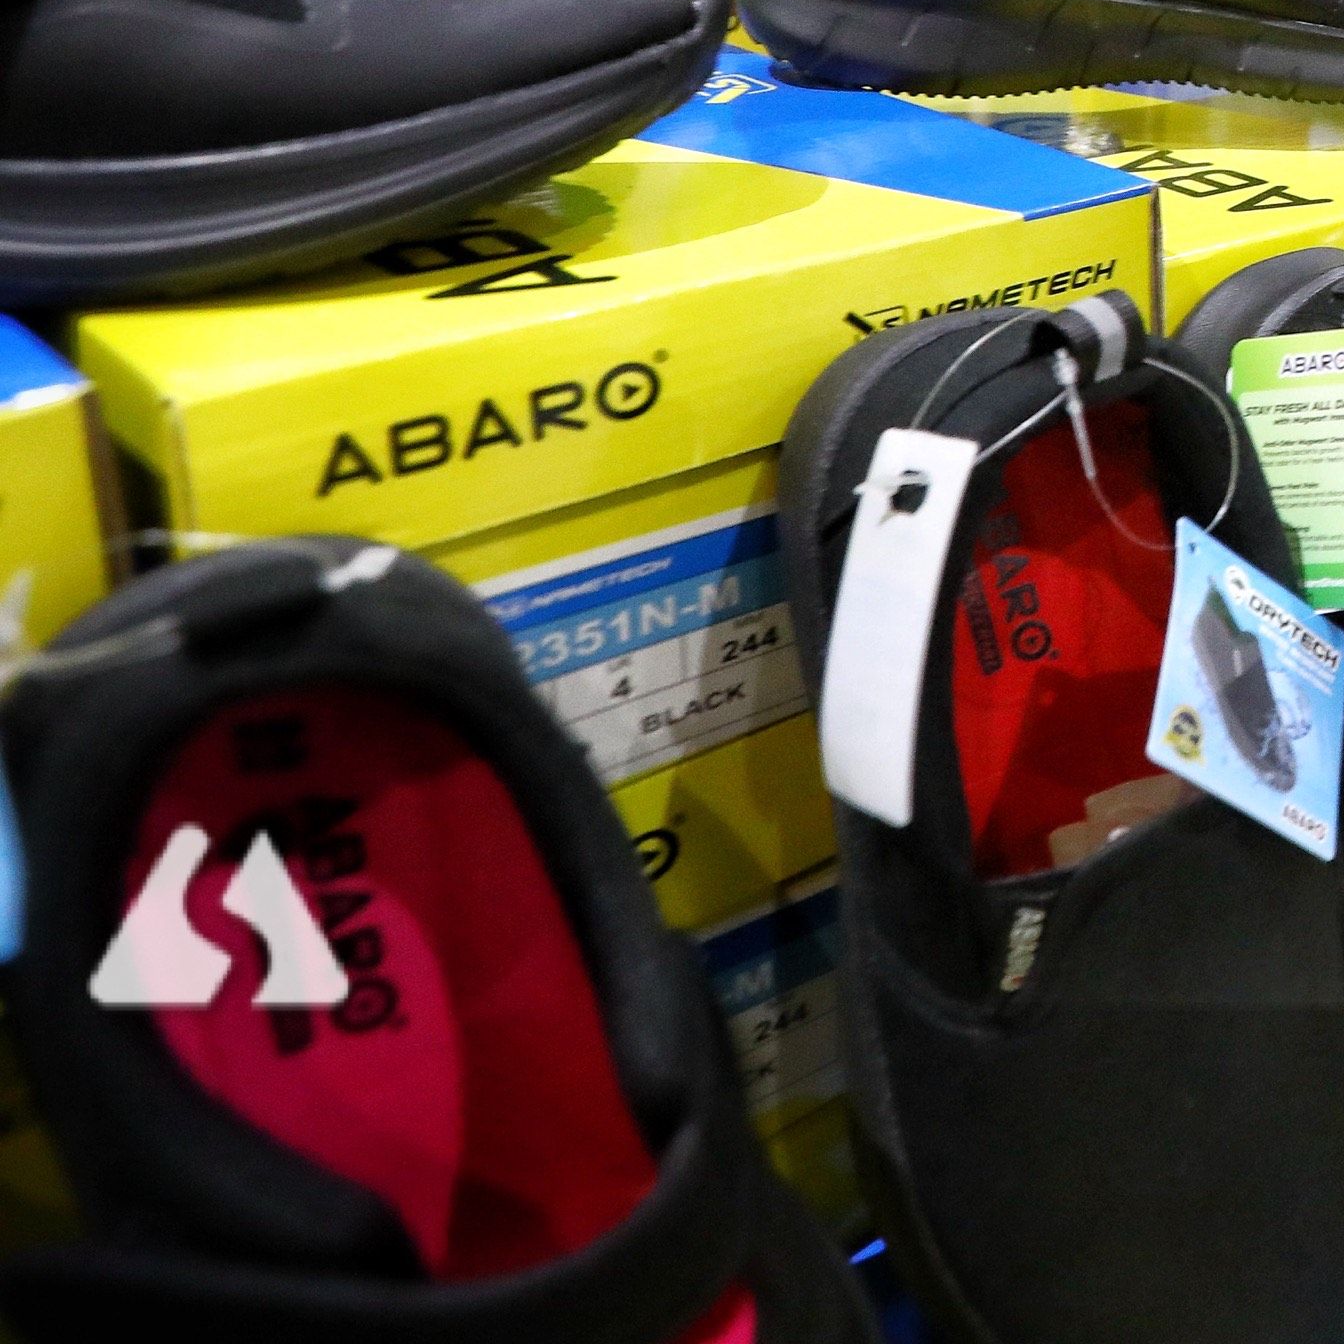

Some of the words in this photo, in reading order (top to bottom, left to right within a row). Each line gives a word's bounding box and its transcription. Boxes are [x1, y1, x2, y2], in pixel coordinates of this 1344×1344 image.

[315, 359, 661, 498] ABARO
[1274, 402, 1310, 415] FRESH
[1312, 400, 1331, 411] ALL
[722, 626, 779, 663] 244
[1249, 595, 1339, 668] DRYTECH
[610, 676, 634, 699] 4
[640, 681, 745, 735] BLACK
